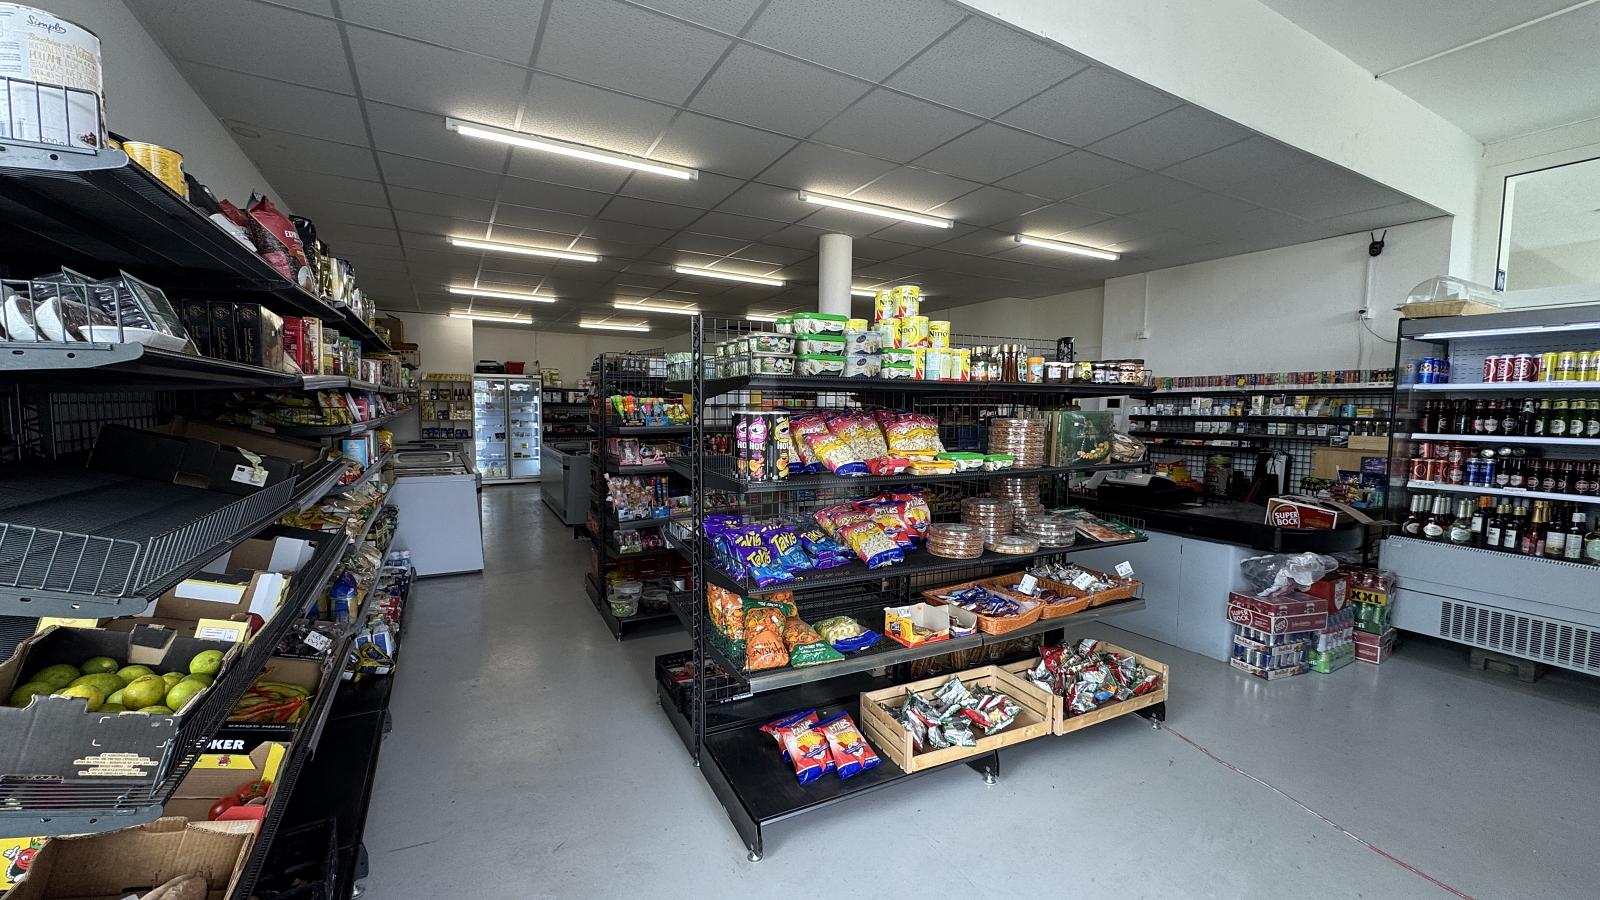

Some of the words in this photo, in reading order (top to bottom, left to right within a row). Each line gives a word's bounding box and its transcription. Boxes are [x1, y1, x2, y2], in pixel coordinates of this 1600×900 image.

[1274, 511, 1298, 520] SUPER
[1276, 518, 1299, 526] BOCK
[771, 532, 798, 557] Takis
[746, 549, 772, 568] Takis
[1351, 590, 1382, 605] XXL
